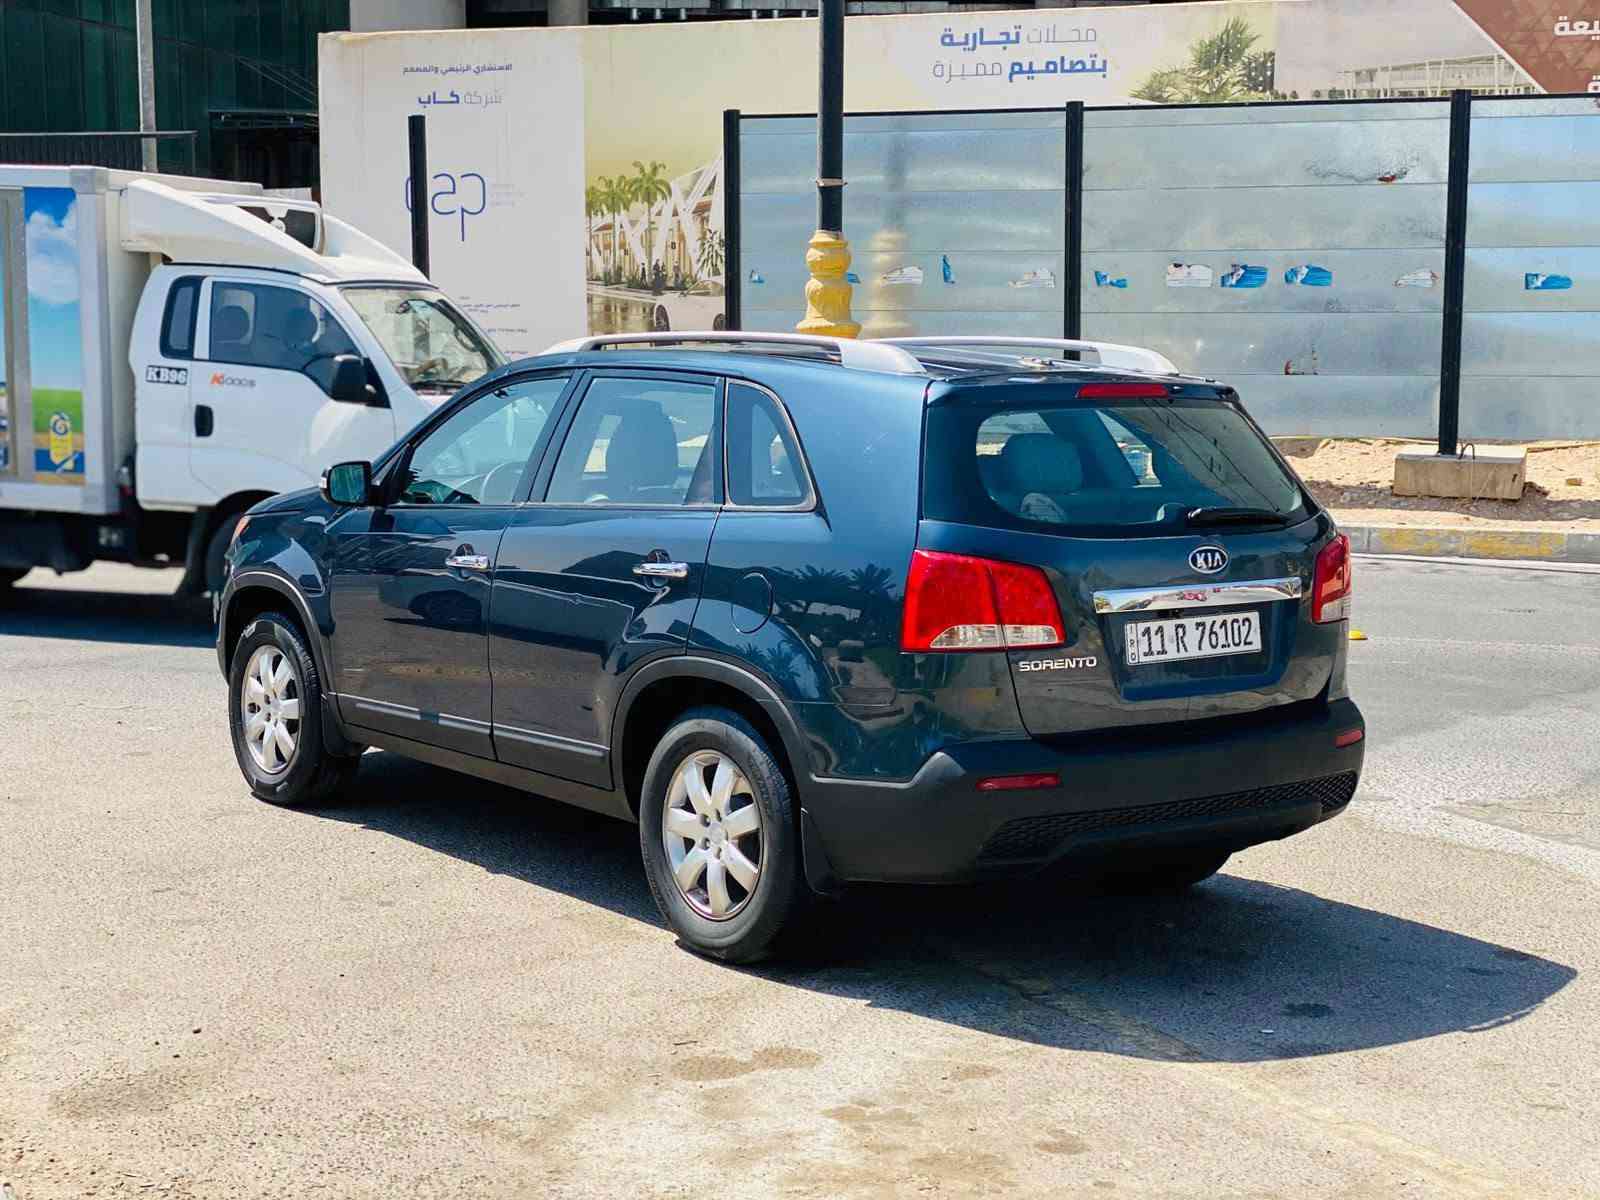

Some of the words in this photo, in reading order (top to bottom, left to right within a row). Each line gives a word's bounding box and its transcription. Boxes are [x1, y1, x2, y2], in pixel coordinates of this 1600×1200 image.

[940, 25, 1022, 51] تجارية
[1026, 24, 1097, 44] محلات
[933, 61, 1002, 84] مميزة
[1008, 53, 1107, 82] بتصاميم
[418, 90, 460, 108] كاب
[464, 89, 502, 109] شركة
[147, 367, 188, 385] KB96
[1196, 552, 1223, 569] KIA
[1141, 625, 1168, 657] 11
[1174, 623, 1188, 653] R
[1195, 617, 1253, 651] 76102
[1018, 656, 1097, 672] SORENTO
